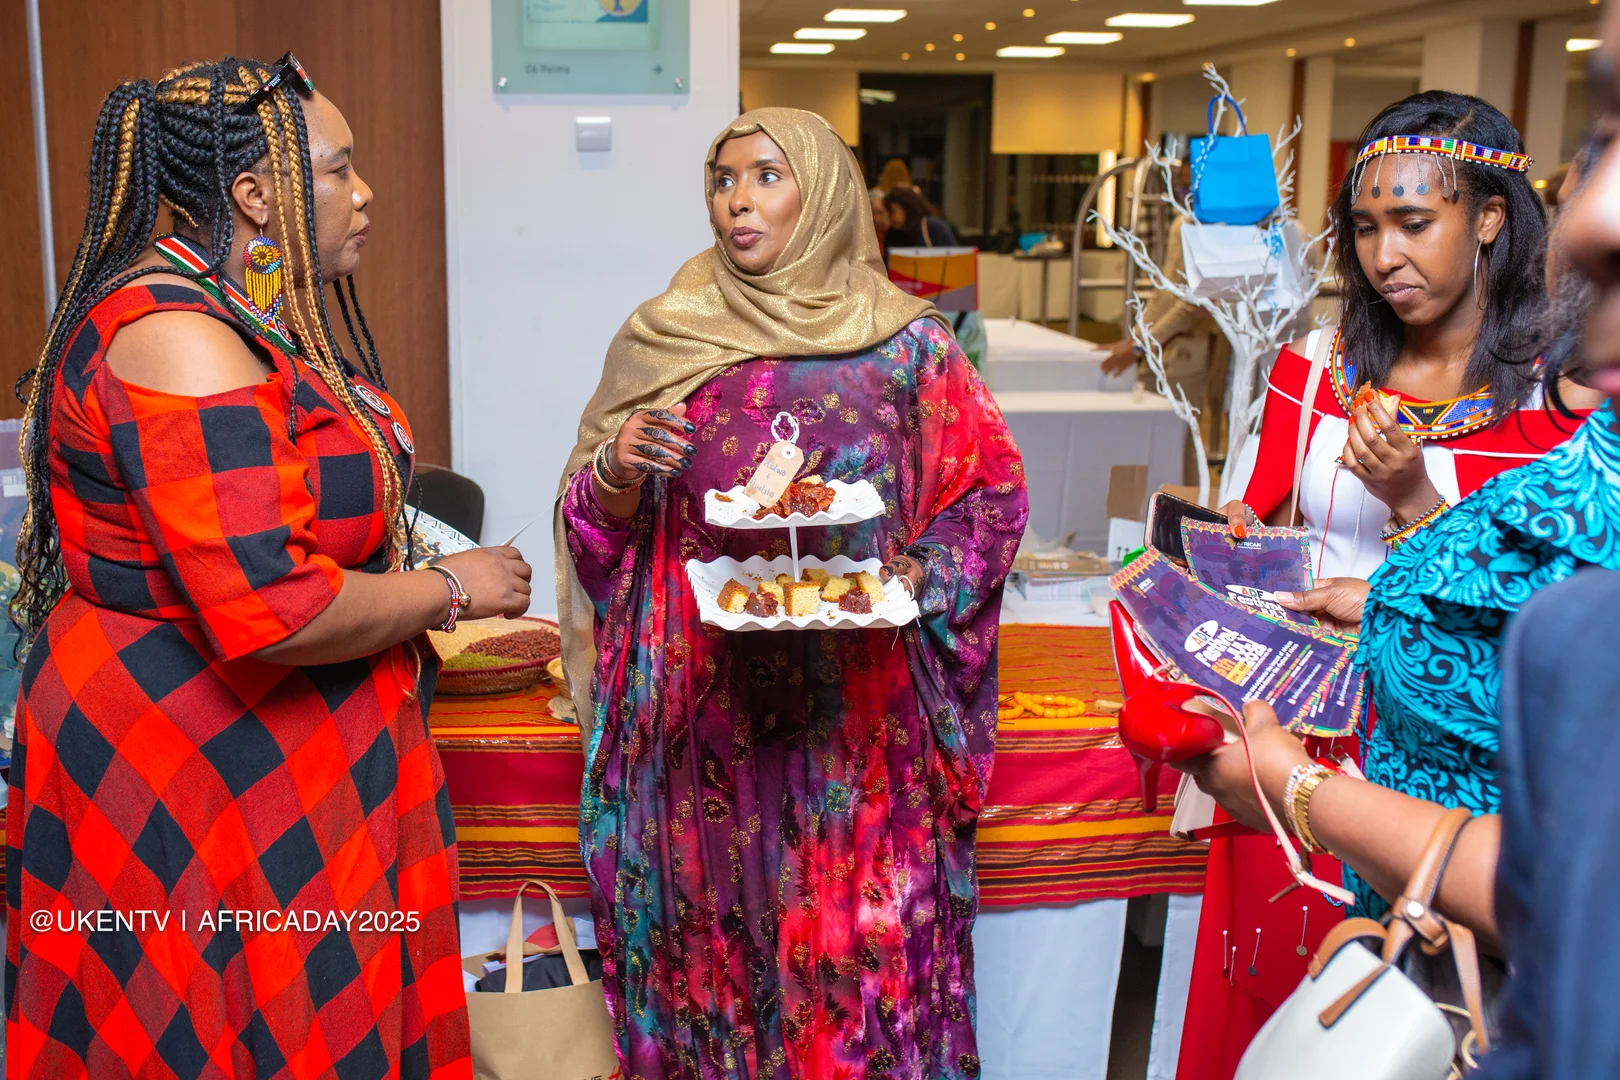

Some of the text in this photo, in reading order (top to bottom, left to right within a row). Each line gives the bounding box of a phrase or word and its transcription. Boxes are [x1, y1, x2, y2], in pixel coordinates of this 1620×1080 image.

[1242, 587, 1264, 599] ADF
[1191, 626, 1212, 648] ADF
[1194, 626, 1240, 668] Festival
[1210, 657, 1238, 679] 5th
[1226, 633, 1255, 661] JULY
